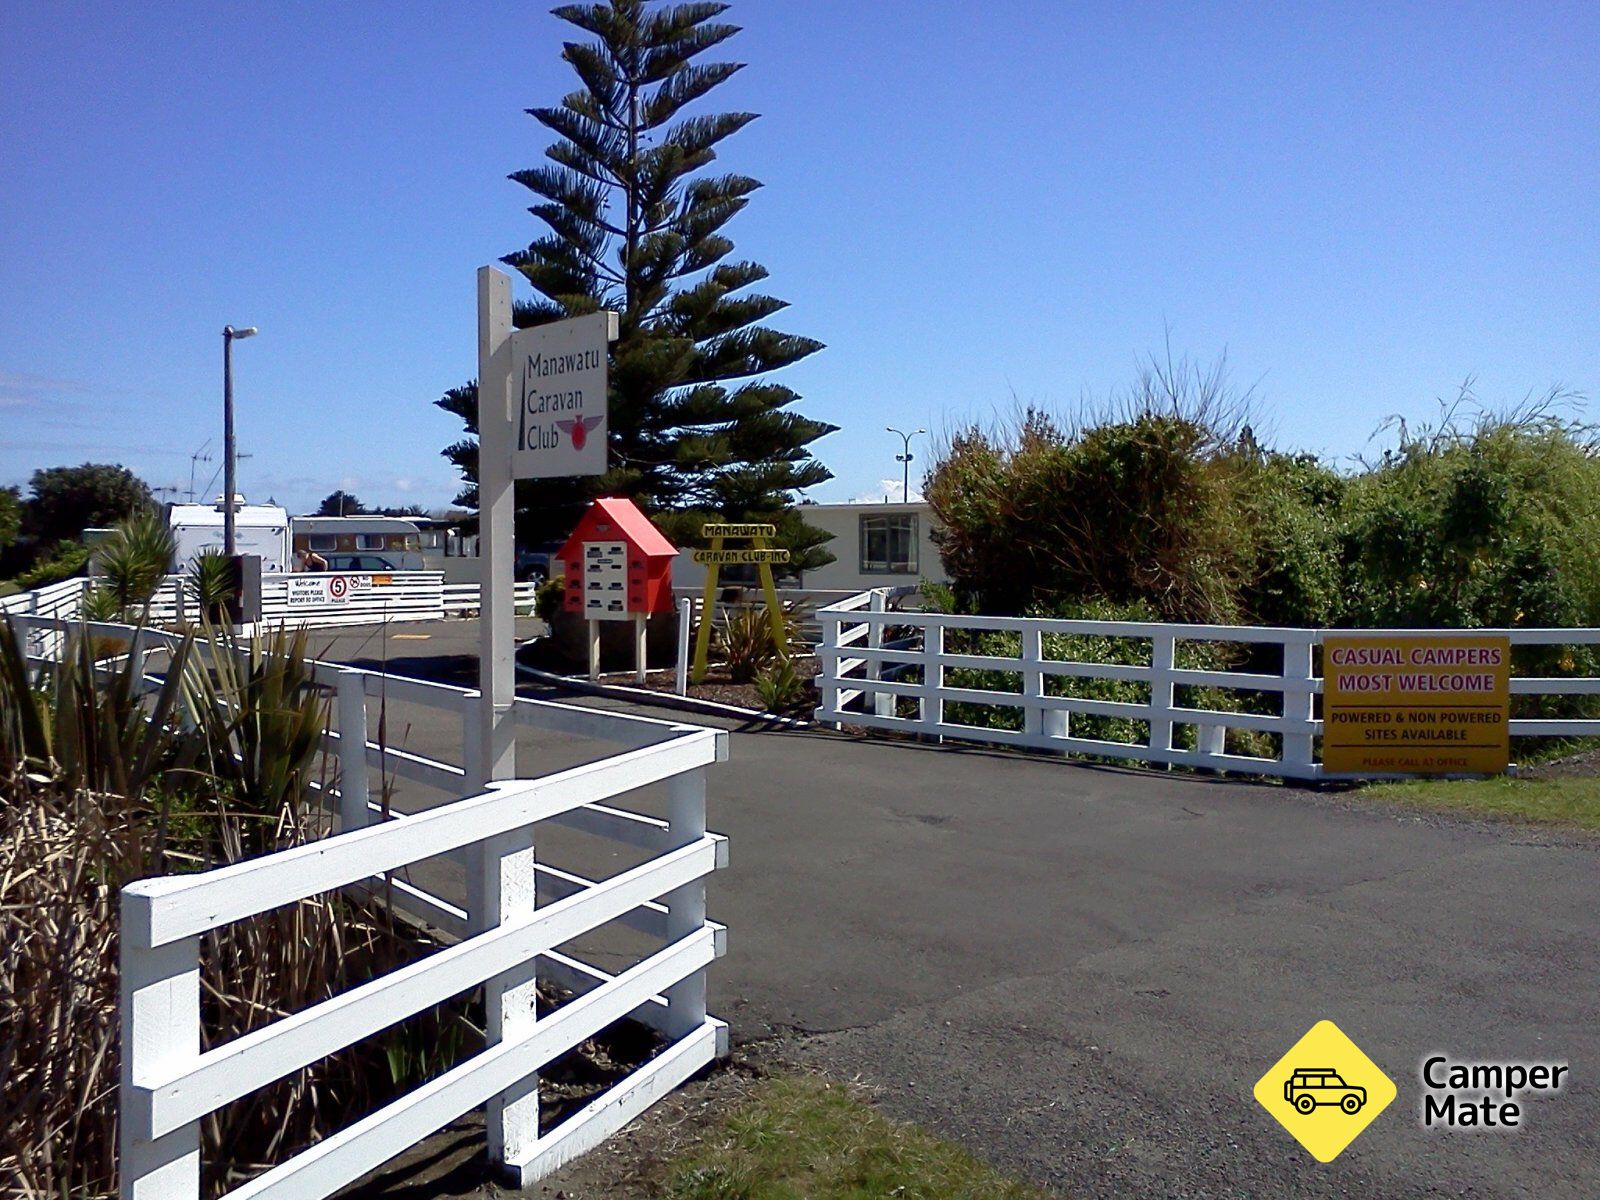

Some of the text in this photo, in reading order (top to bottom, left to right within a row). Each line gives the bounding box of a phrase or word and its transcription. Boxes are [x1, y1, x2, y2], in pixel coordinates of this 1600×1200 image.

[527, 349, 600, 378] Manawatu
[527, 389, 583, 415] Caravan
[527, 423, 559, 450] Club
[705, 525, 773, 536] MANAWATU
[693, 551, 738, 562] CARAVAN
[334, 580, 342, 593] 5
[1331, 648, 1502, 666] CASUAL CAMPERS
[1339, 674, 1494, 692] MOST WELCOME
[1331, 712, 1502, 724] POWERED & NON POWERED
[1364, 729, 1468, 740] SITES AVAILABLE
[1362, 757, 1468, 767] PLEASE CALL AT OFFICE
